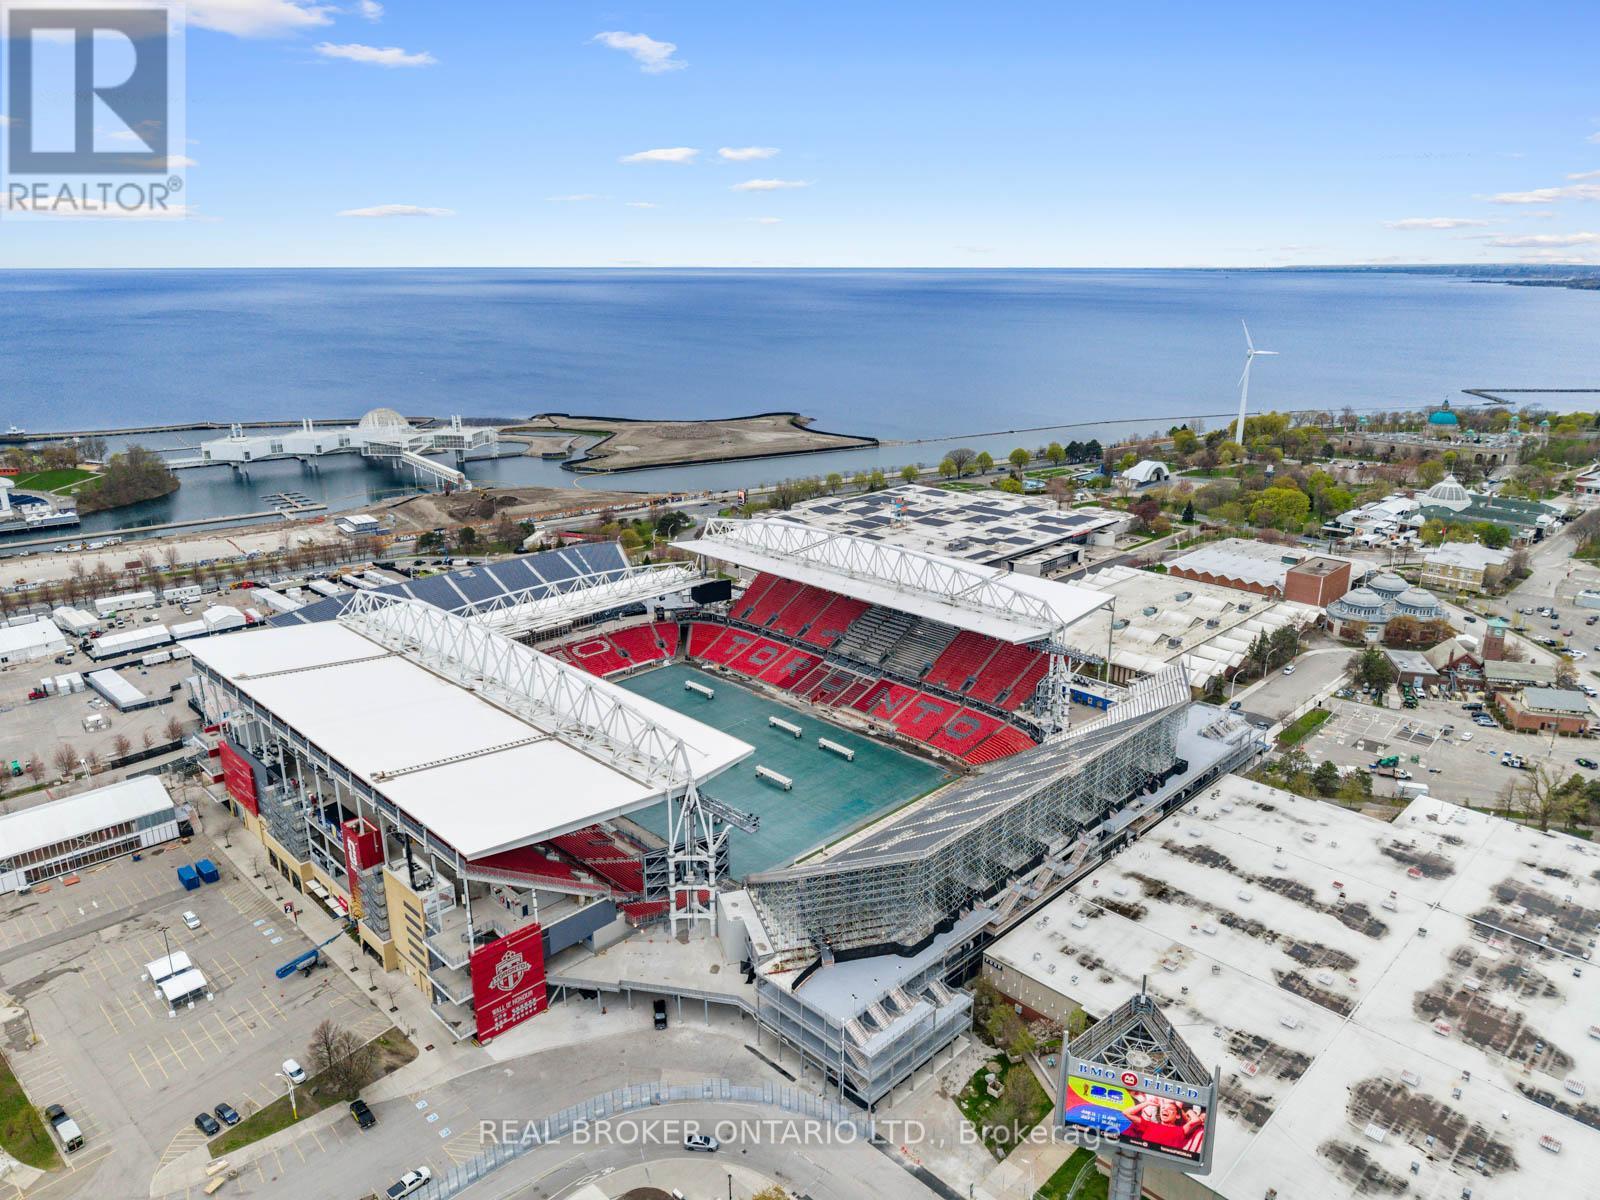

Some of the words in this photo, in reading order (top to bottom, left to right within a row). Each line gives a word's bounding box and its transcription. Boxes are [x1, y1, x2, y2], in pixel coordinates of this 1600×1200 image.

[725, 635, 980, 739] TORONTO
[495, 963, 526, 982] TORONTO
[1078, 1064, 1116, 1080] BMO
[1143, 1078, 1199, 1099] FIELD
